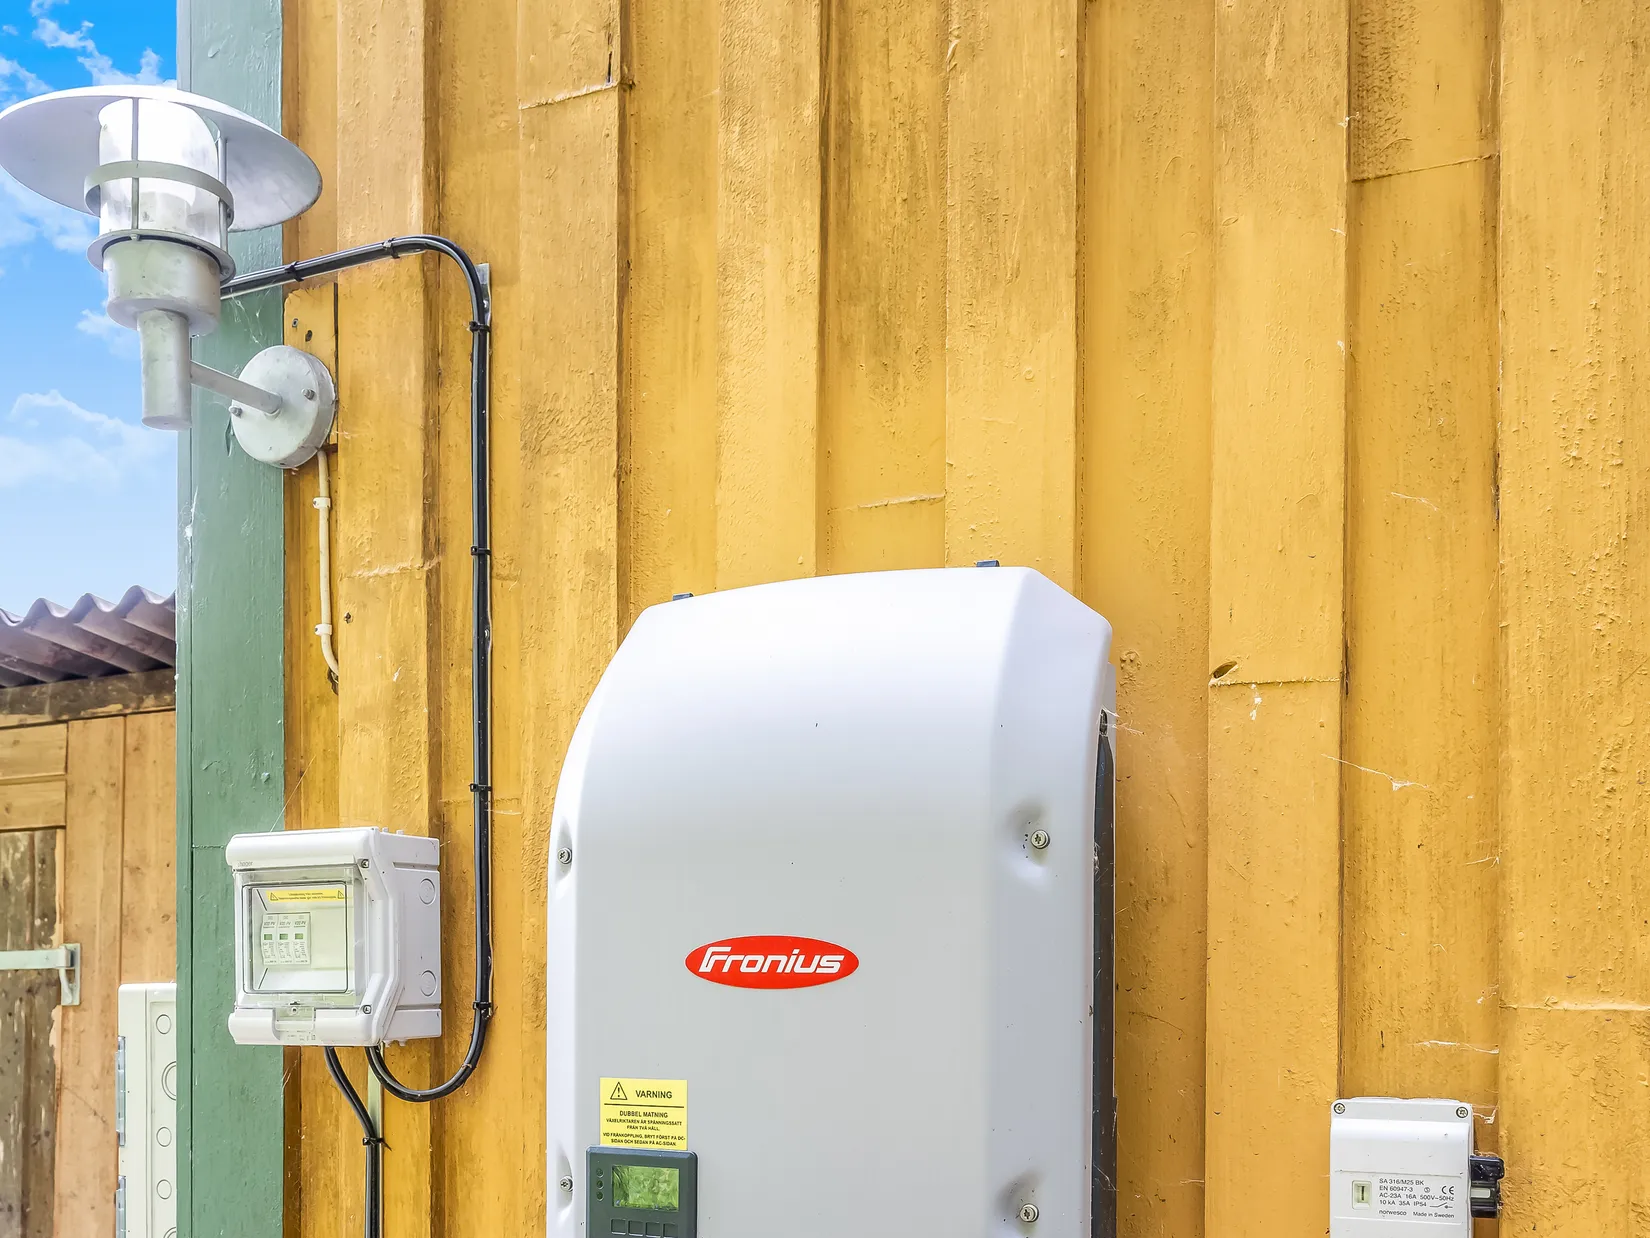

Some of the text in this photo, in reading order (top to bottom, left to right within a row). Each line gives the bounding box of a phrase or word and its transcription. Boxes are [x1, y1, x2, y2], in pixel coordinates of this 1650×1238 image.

[698, 946, 845, 974] Fronius
[635, 1090, 672, 1099] VARNING
[1442, 1186, 1454, 1195] CE
